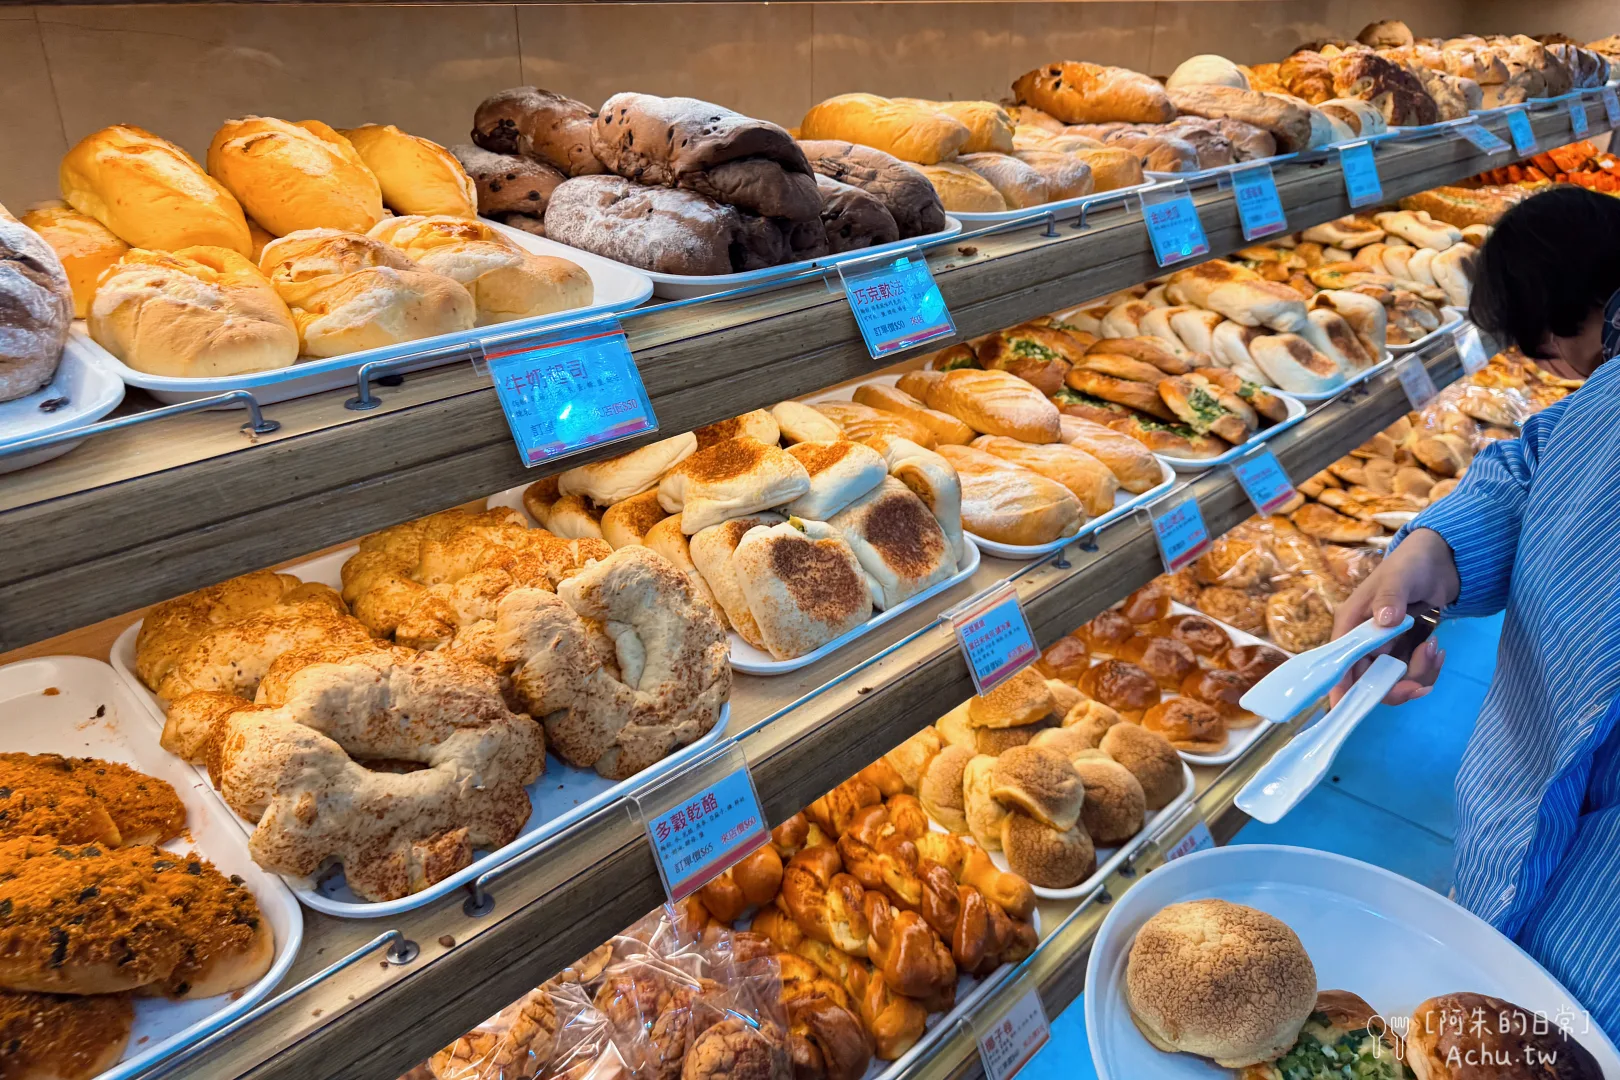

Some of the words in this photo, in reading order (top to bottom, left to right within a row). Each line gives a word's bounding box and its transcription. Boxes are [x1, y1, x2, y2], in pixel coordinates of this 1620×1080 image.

[853, 280, 906, 306] 巧克軟法
[655, 792, 719, 844] 多穀乾酪
[720, 815, 757, 845] 來店價$60
[673, 841, 714, 875] 訂單價$65
